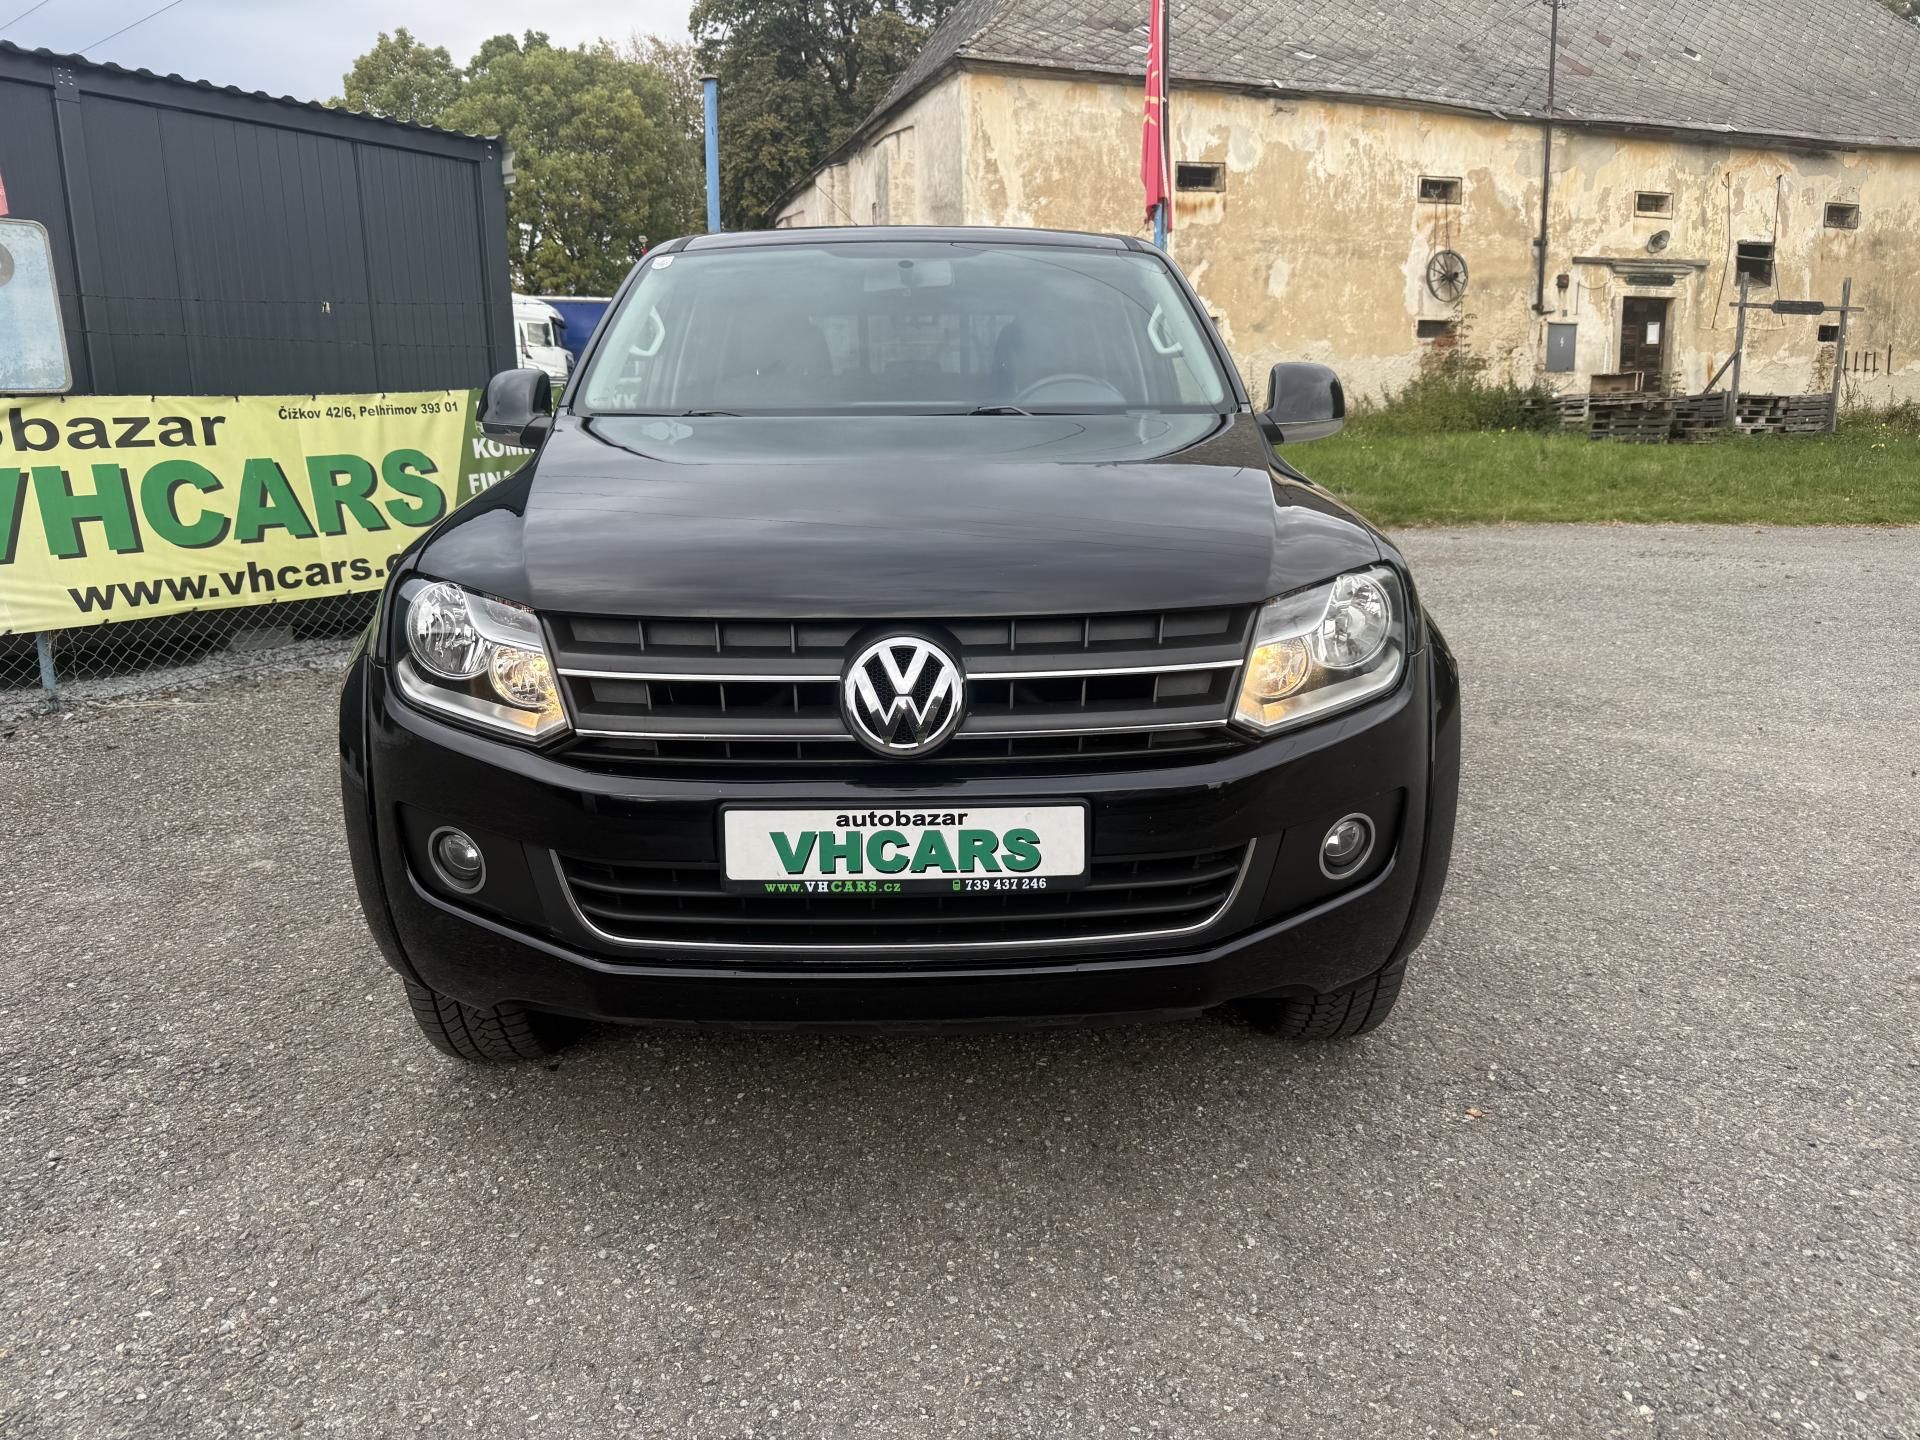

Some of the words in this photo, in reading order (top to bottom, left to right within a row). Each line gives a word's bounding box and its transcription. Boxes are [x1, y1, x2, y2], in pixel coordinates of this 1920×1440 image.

[278, 405, 321, 420] Čížkov
[326, 406, 356, 420] 42/6,
[360, 404, 417, 417] Pelhřimov
[421, 402, 441, 414] 393
[444, 401, 458, 412] 01
[0, 408, 226, 451] bazar
[836, 811, 968, 827] autobazar
[769, 828, 1041, 874] VHCARS
[765, 881, 901, 893] www.VHCARS.cz
[966, 880, 990, 891] 739
[994, 879, 1018, 890] 437
[1022, 878, 1047, 890] 246
